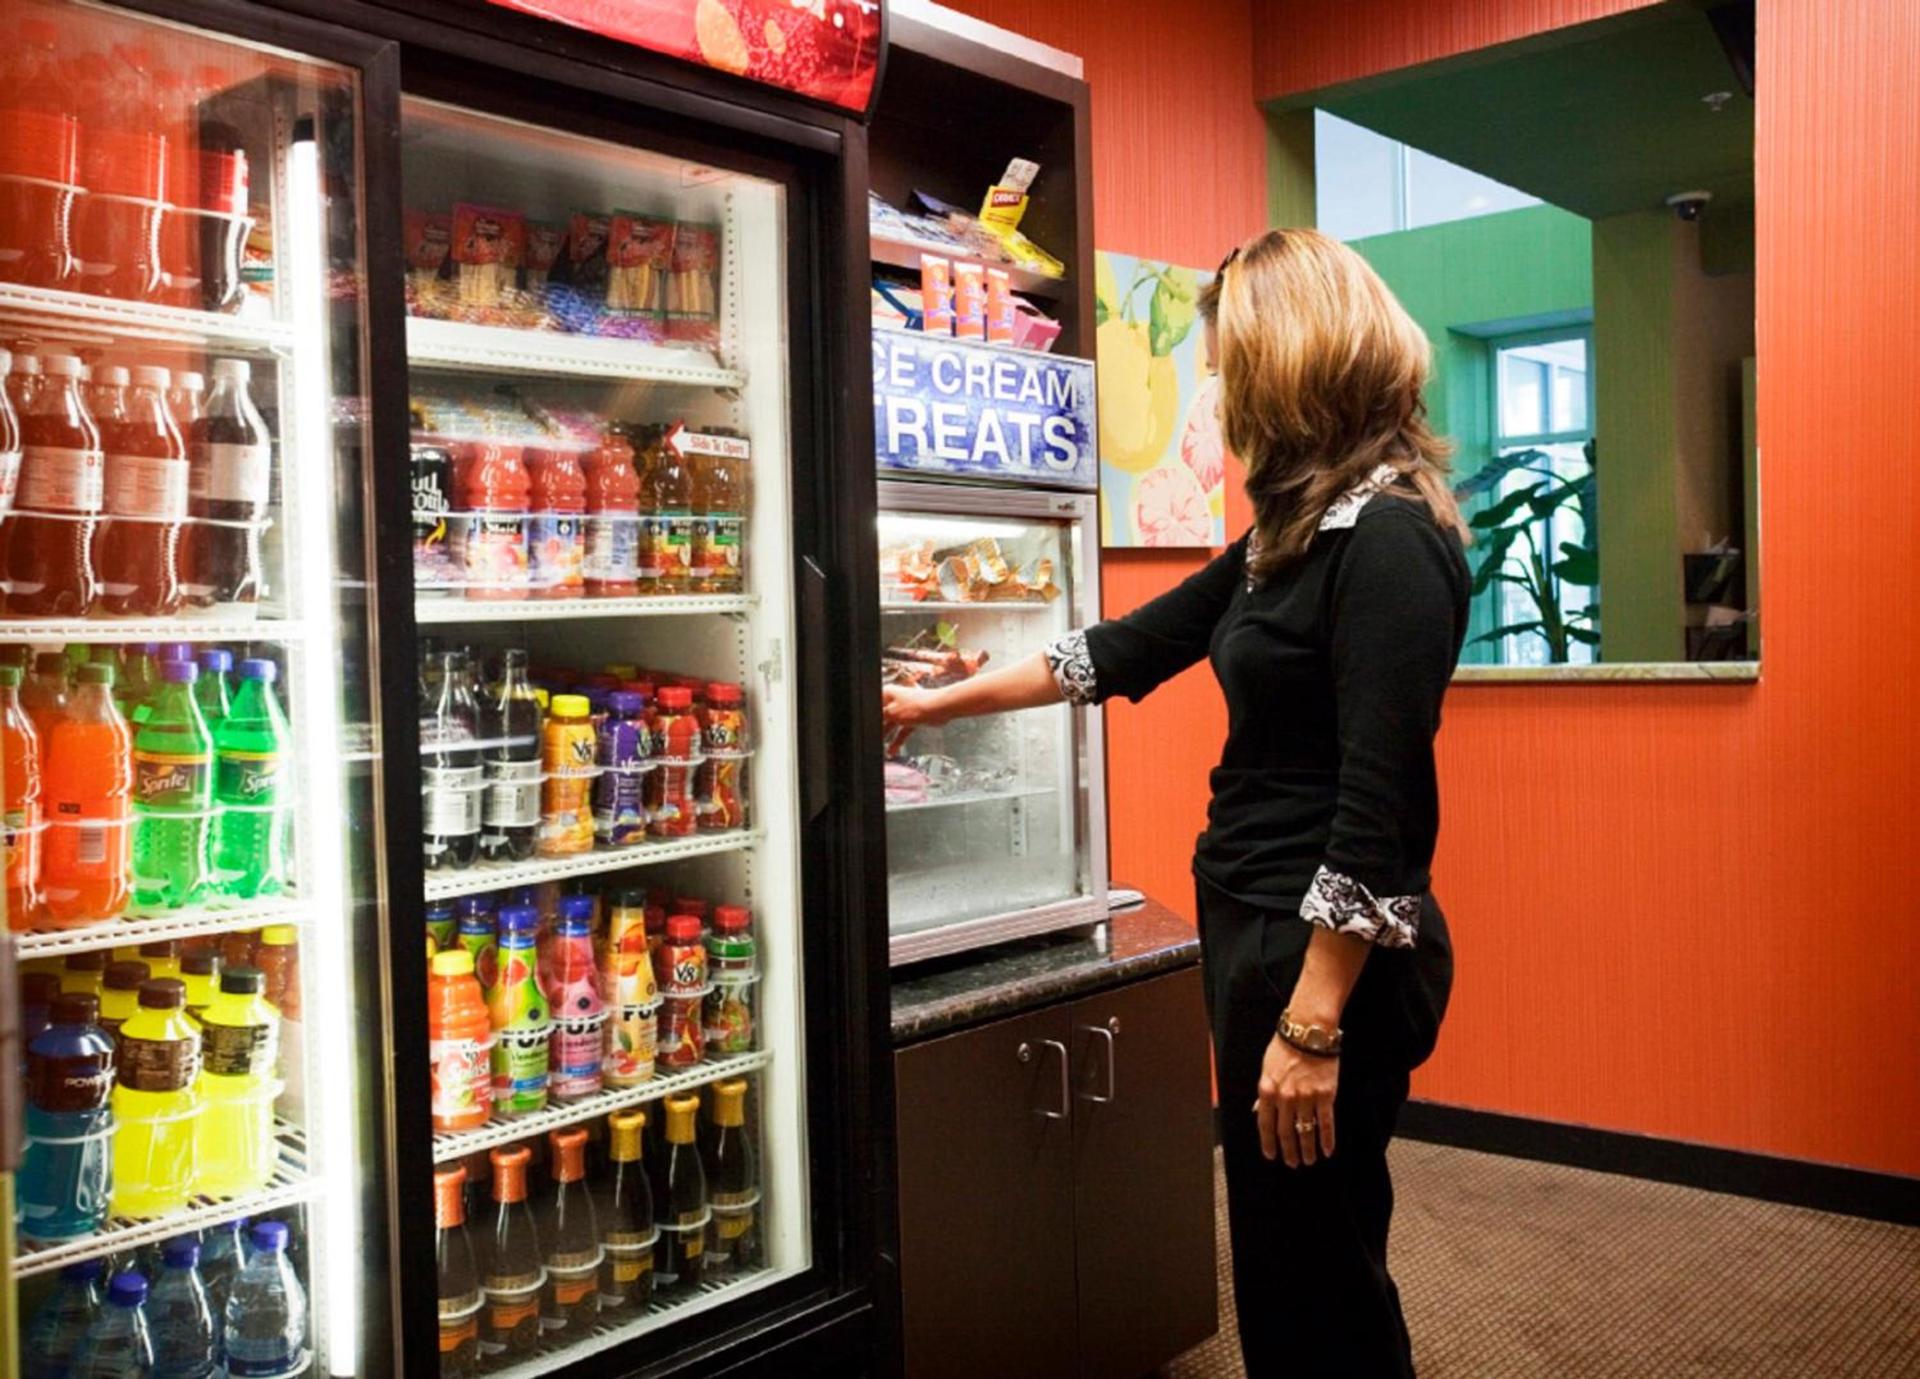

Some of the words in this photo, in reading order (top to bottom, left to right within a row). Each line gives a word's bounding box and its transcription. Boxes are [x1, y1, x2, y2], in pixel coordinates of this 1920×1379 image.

[931, 352, 1078, 410] CREAM
[141, 770, 186, 796] Sprite
[676, 961, 695, 983] V8
[501, 1025, 548, 1048] FUZ
